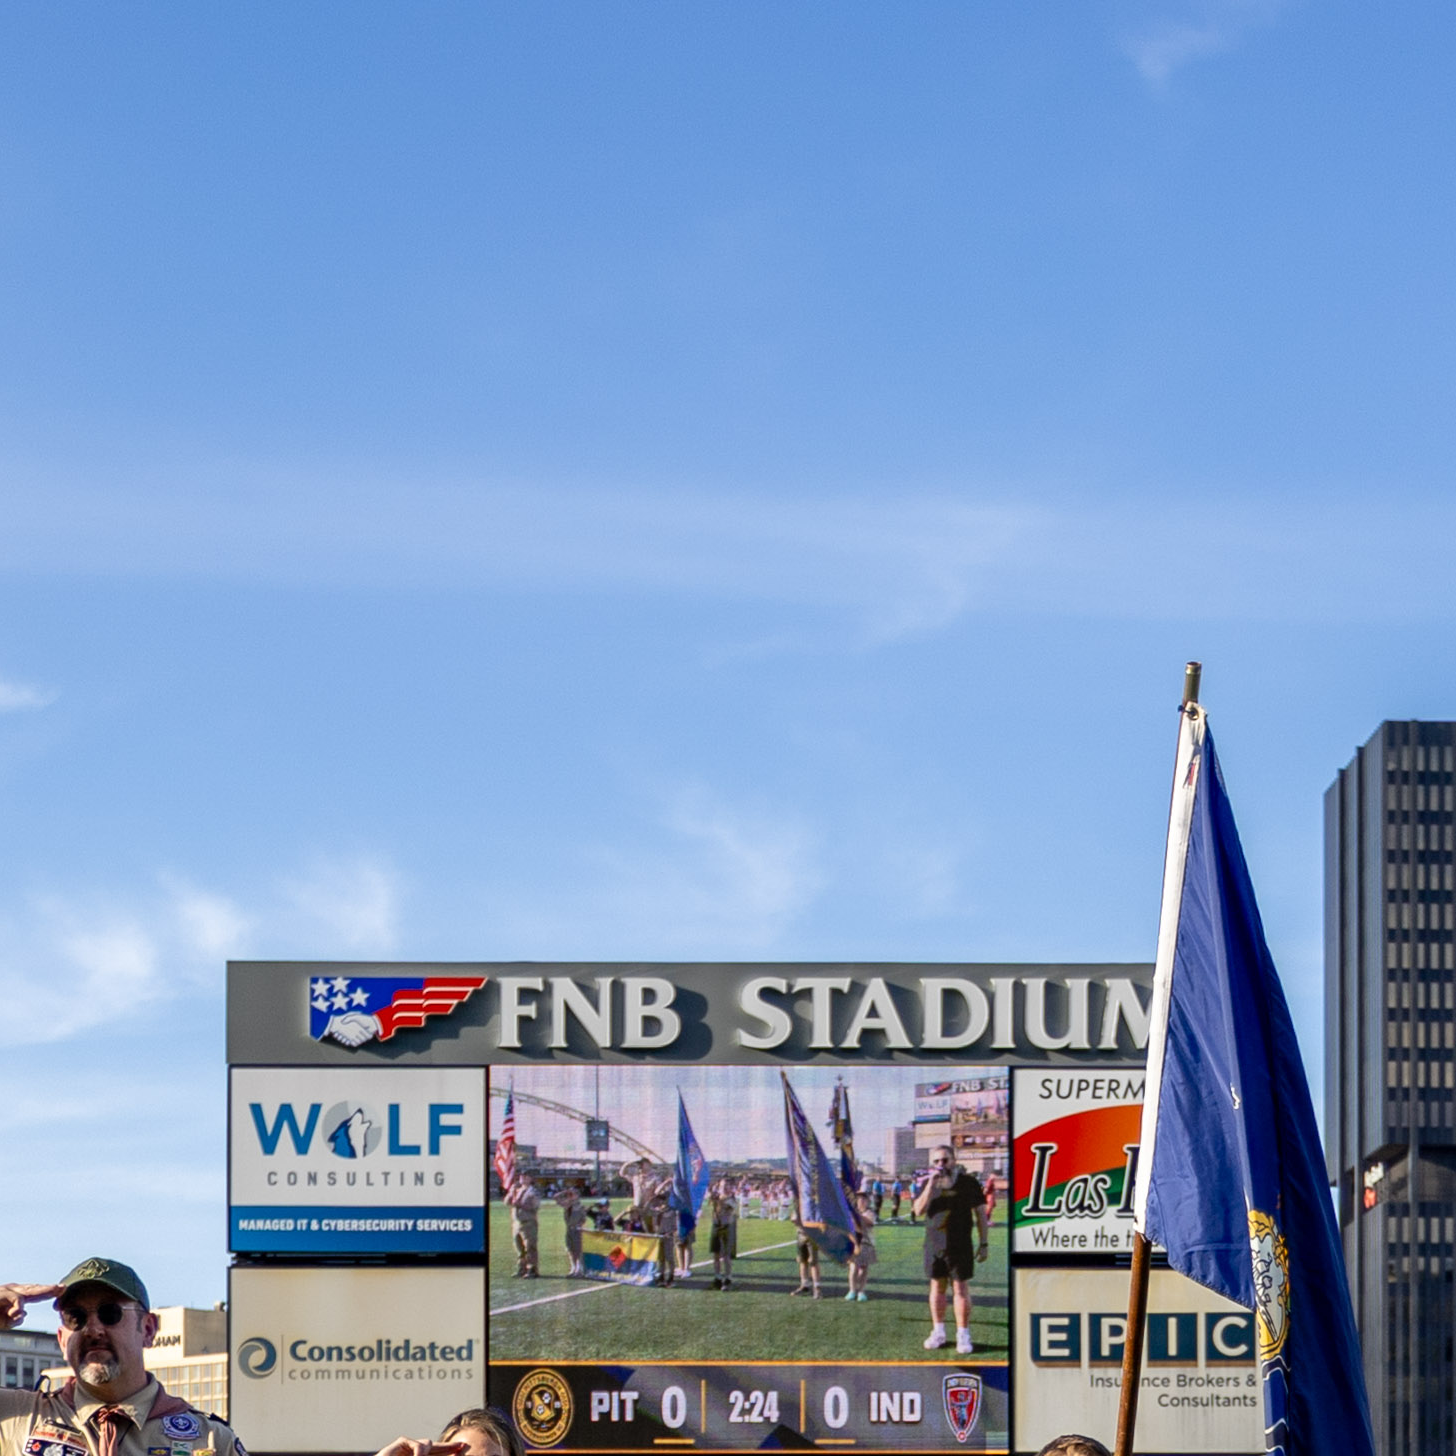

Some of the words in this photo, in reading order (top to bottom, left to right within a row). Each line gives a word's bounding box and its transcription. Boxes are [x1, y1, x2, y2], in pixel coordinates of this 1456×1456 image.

[496, 976, 682, 1049] FNB
[1039, 1078, 1145, 1100] SUPERM
[267, 1171, 446, 1186] CONSULTING
[1024, 1144, 1109, 1217] Las
[238, 1219, 294, 1231] MANAGED
[297, 1219, 308, 1231] IT
[310, 1219, 319, 1231] &
[321, 1219, 415, 1231] CYBERSECURITY
[416, 1219, 473, 1232] SERVICES
[1031, 1226, 1088, 1248] Where
[1094, 1226, 1120, 1248] the
[1039, 1316, 1249, 1357] EPIC
[289, 1339, 473, 1362] Consolidated
[288, 1365, 473, 1380] communications
[1090, 1374, 1170, 1388] Insunce
[1177, 1374, 1237, 1388] Brokers
[1240, 1374, 1257, 1388] &
[591, 1391, 639, 1422] PIT
[661, 1385, 687, 1429] 0
[729, 1390, 780, 1423] 2:24
[823, 1386, 849, 1429] 0
[869, 1391, 922, 1423] IND
[1157, 1394, 1257, 1408] Consultants
